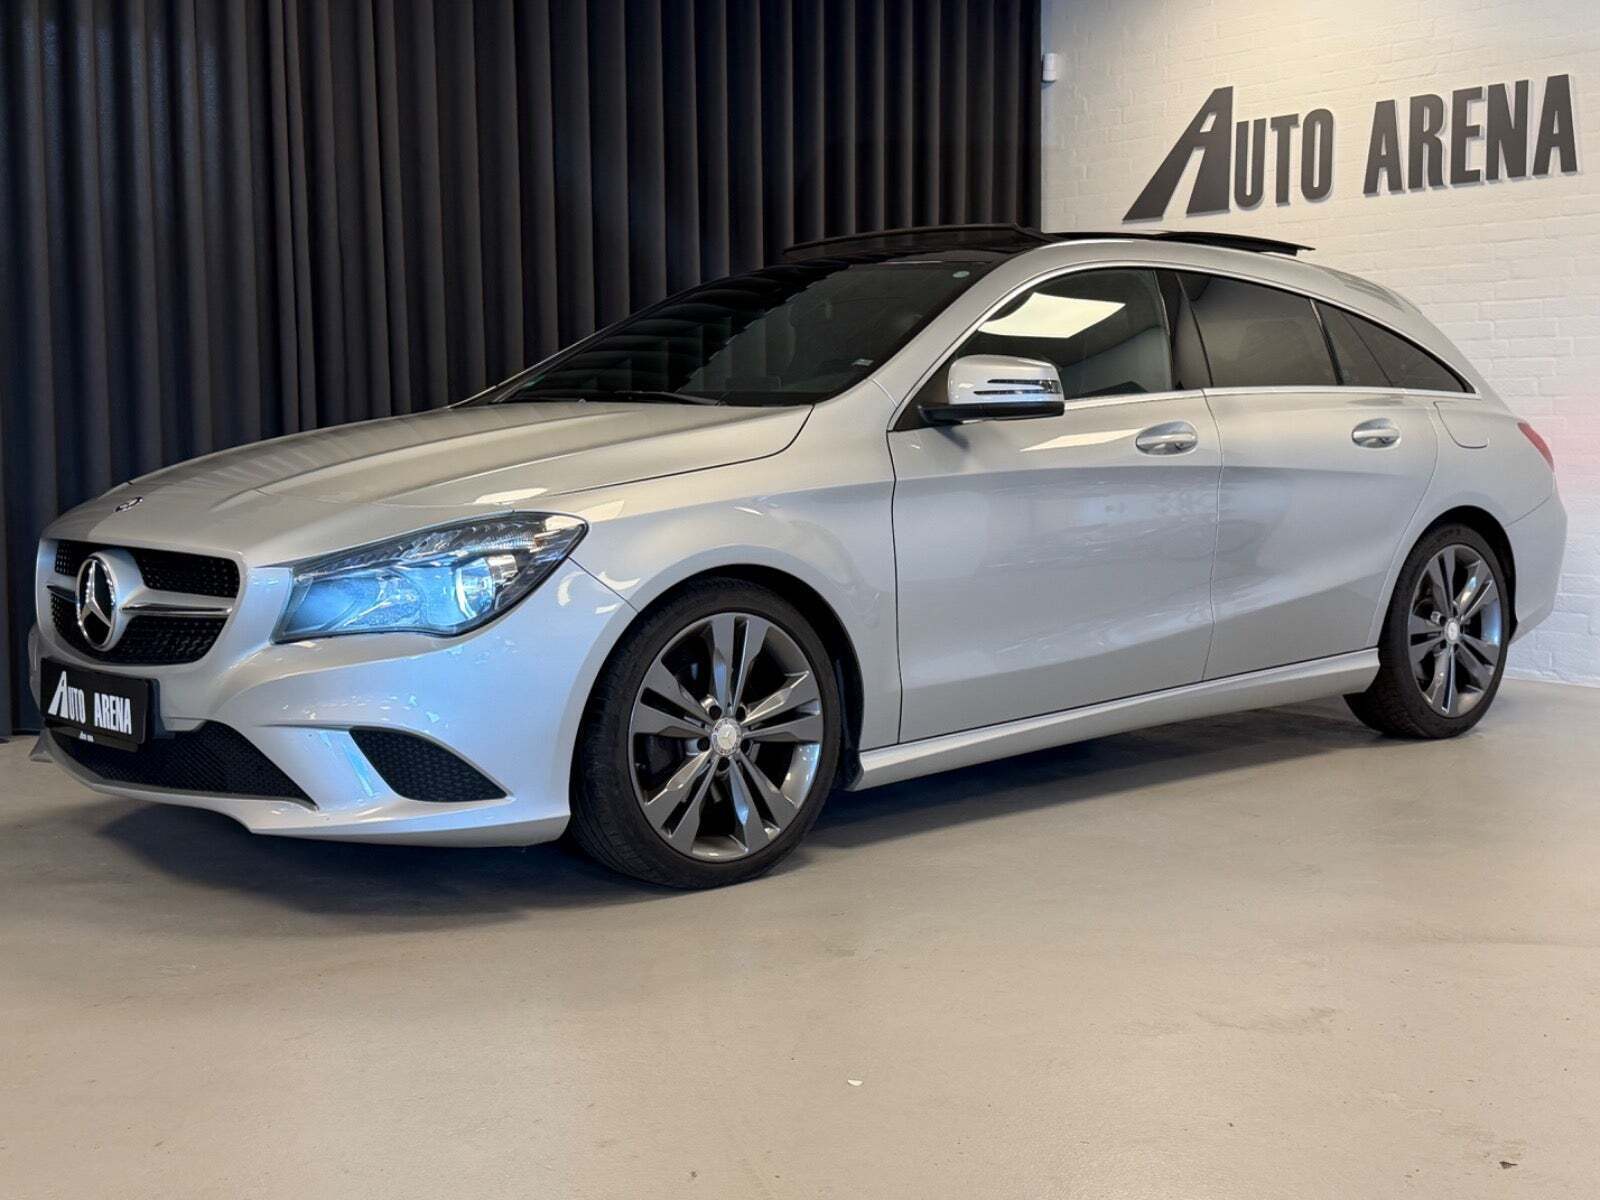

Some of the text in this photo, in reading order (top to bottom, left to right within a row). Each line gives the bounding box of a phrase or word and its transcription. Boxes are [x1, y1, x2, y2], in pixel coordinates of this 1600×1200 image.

[1122, 74, 1578, 222] AUTO ARENA
[47, 670, 132, 735] AUTO ARENA
